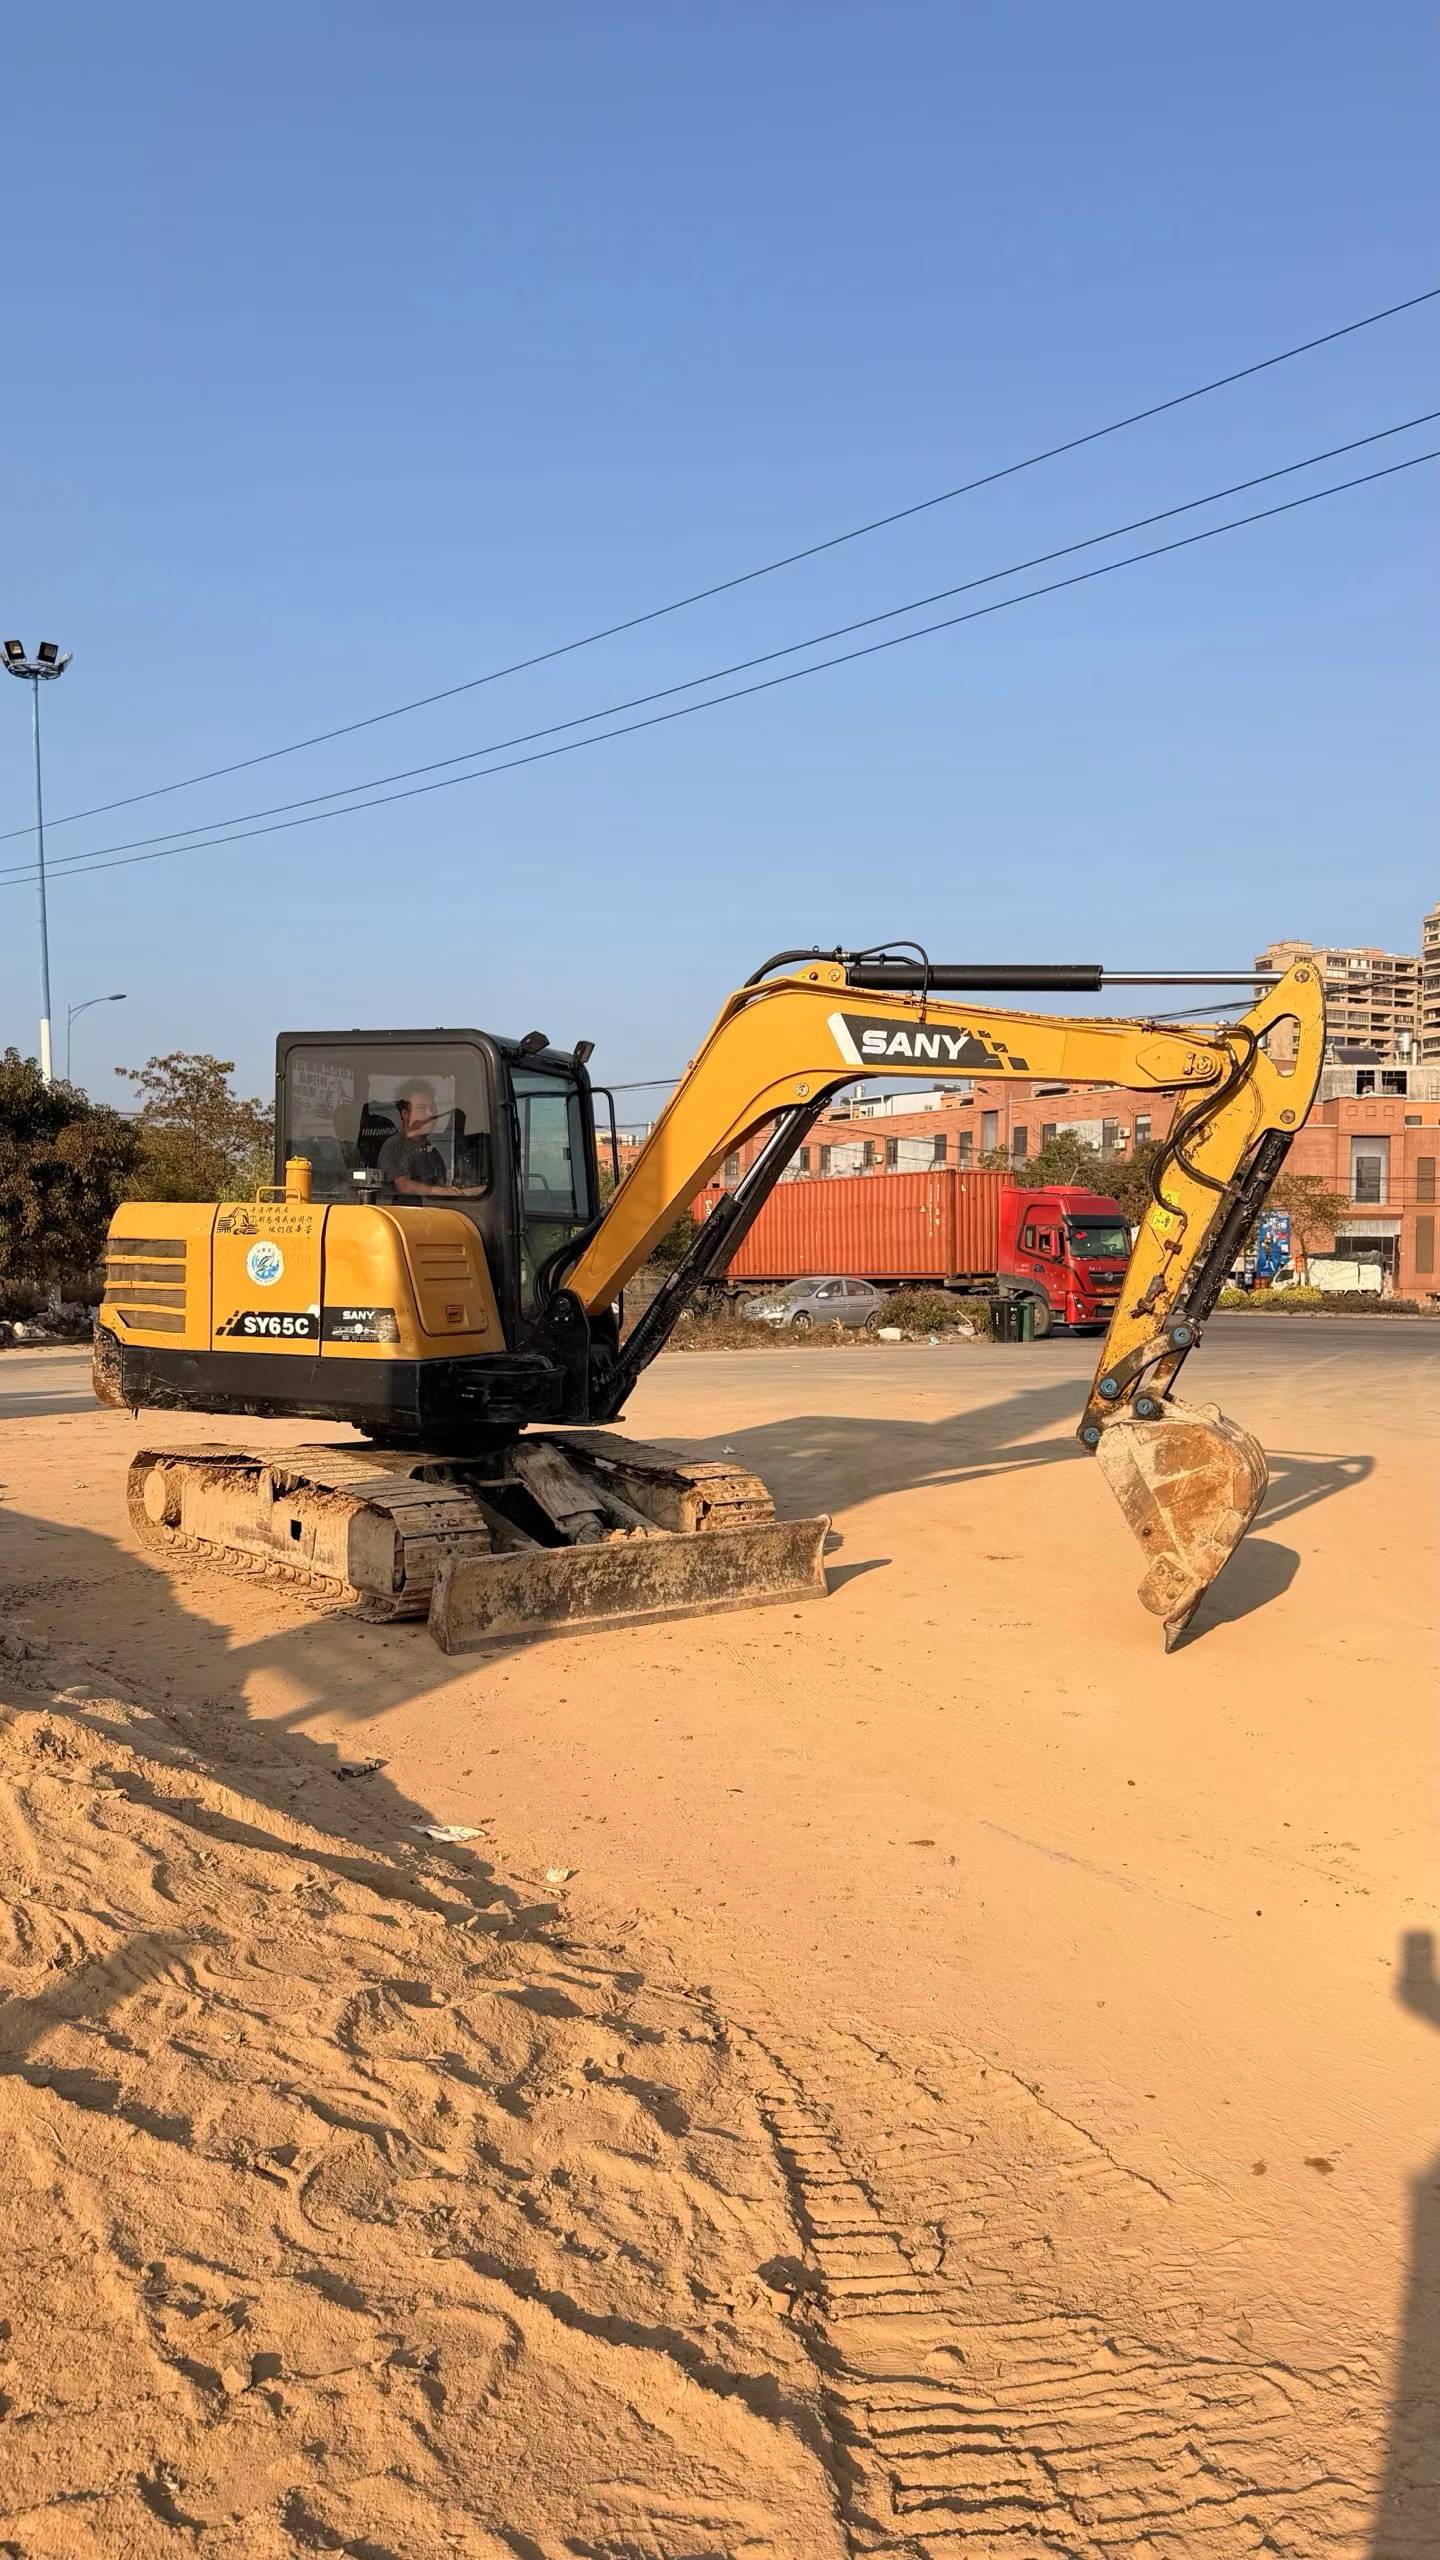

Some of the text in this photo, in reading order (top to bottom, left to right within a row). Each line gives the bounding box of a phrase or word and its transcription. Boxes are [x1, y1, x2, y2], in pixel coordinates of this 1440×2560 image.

[861, 1029, 970, 1060] SANY
[342, 1310, 376, 1320] SANY
[243, 1316, 310, 1336] SY65C
